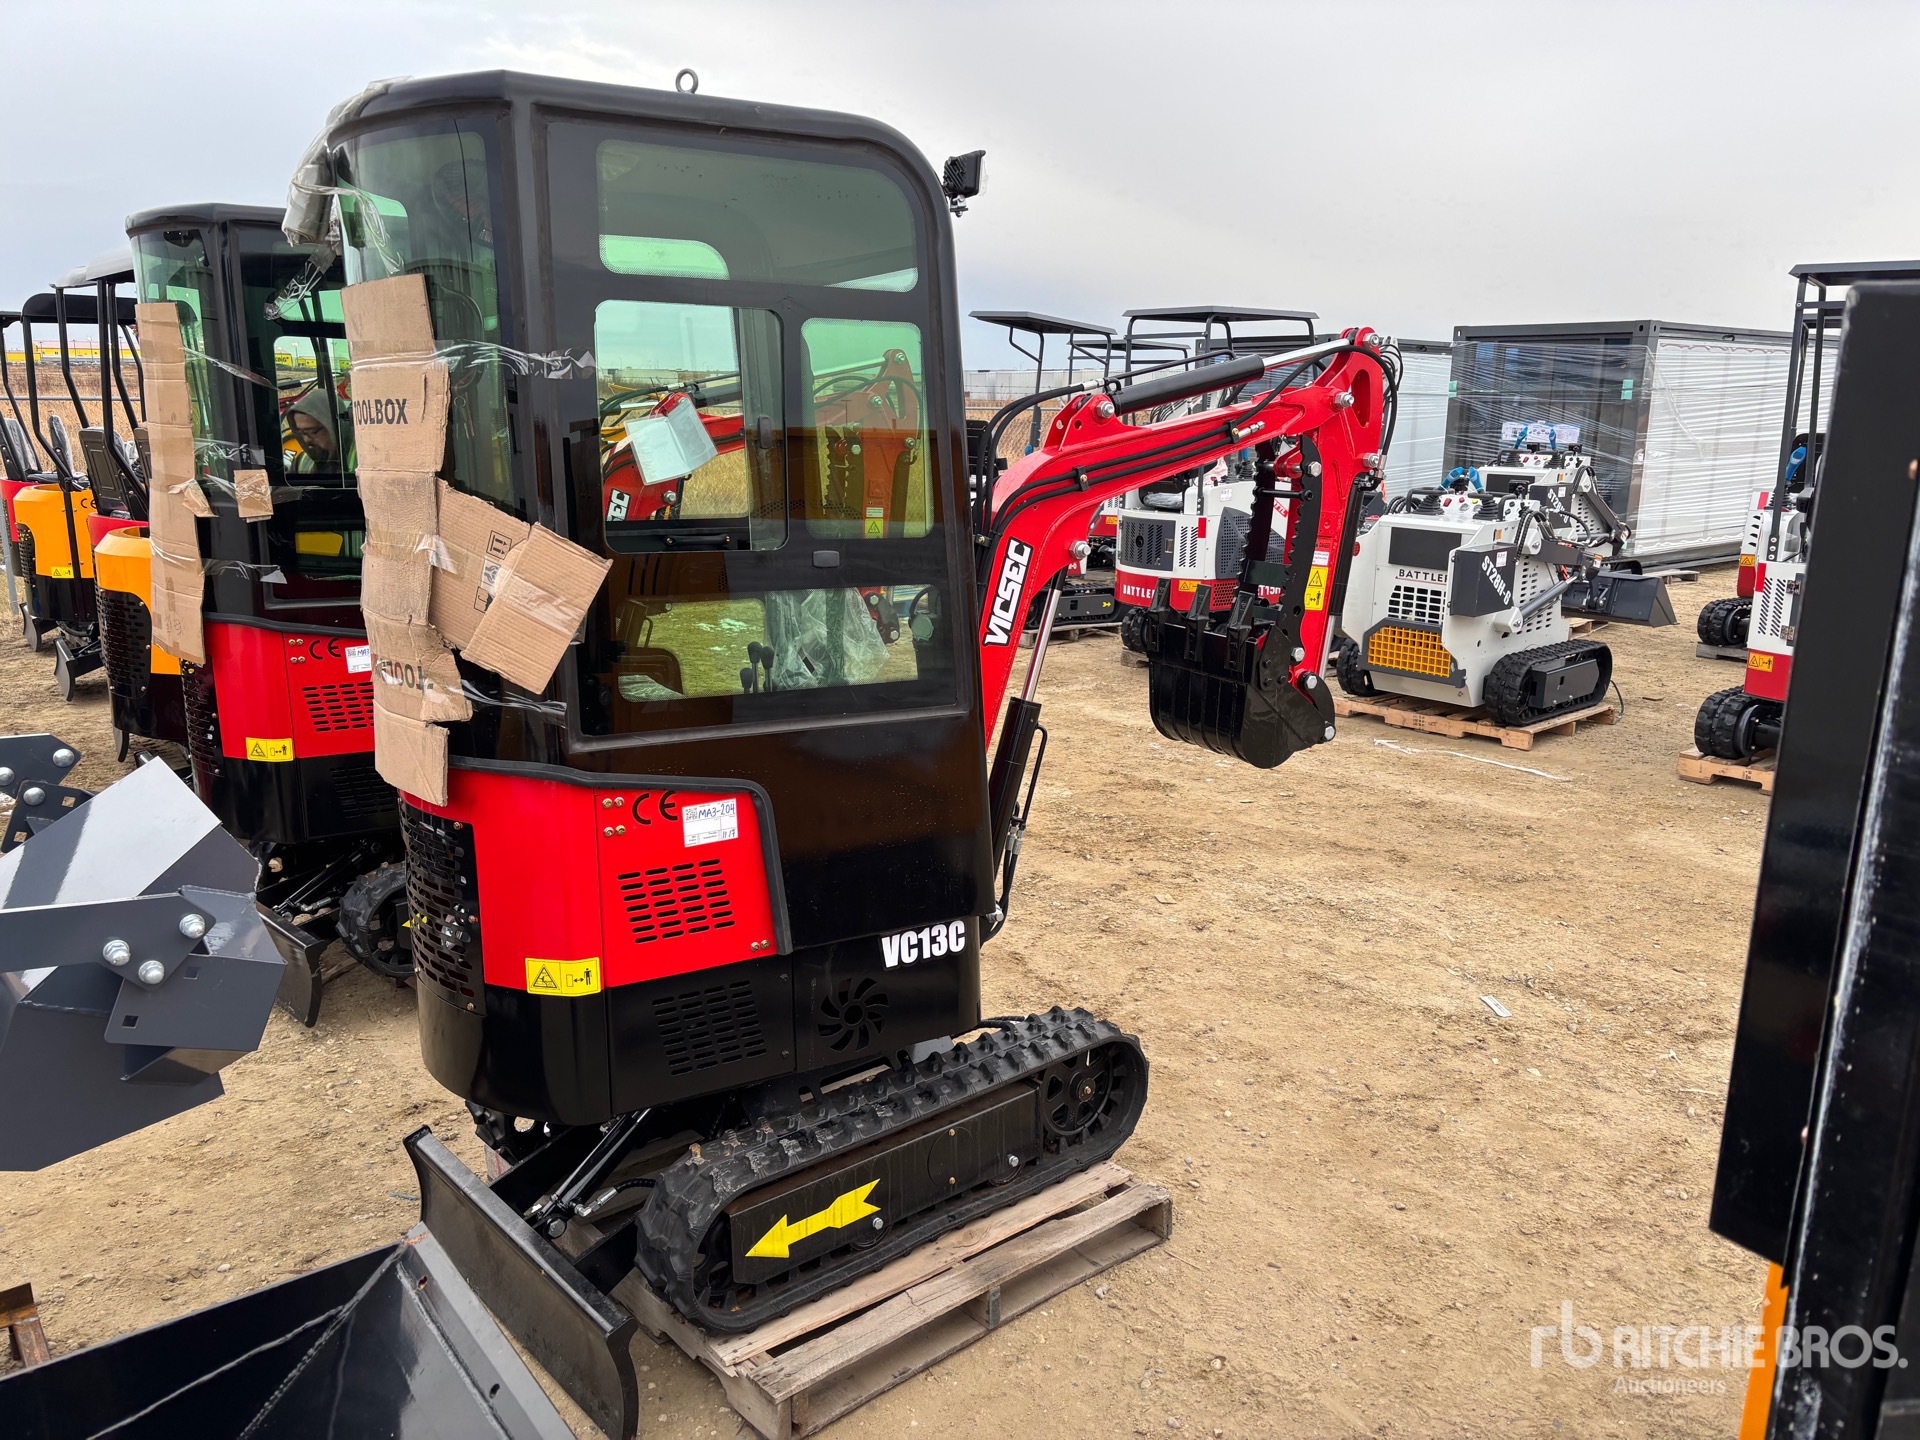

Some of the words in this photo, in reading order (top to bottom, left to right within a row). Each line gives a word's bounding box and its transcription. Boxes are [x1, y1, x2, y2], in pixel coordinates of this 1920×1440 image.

[984, 539, 1031, 644] VICSEC
[698, 803, 735, 819] MA3-204
[881, 920, 965, 968] VC13C
